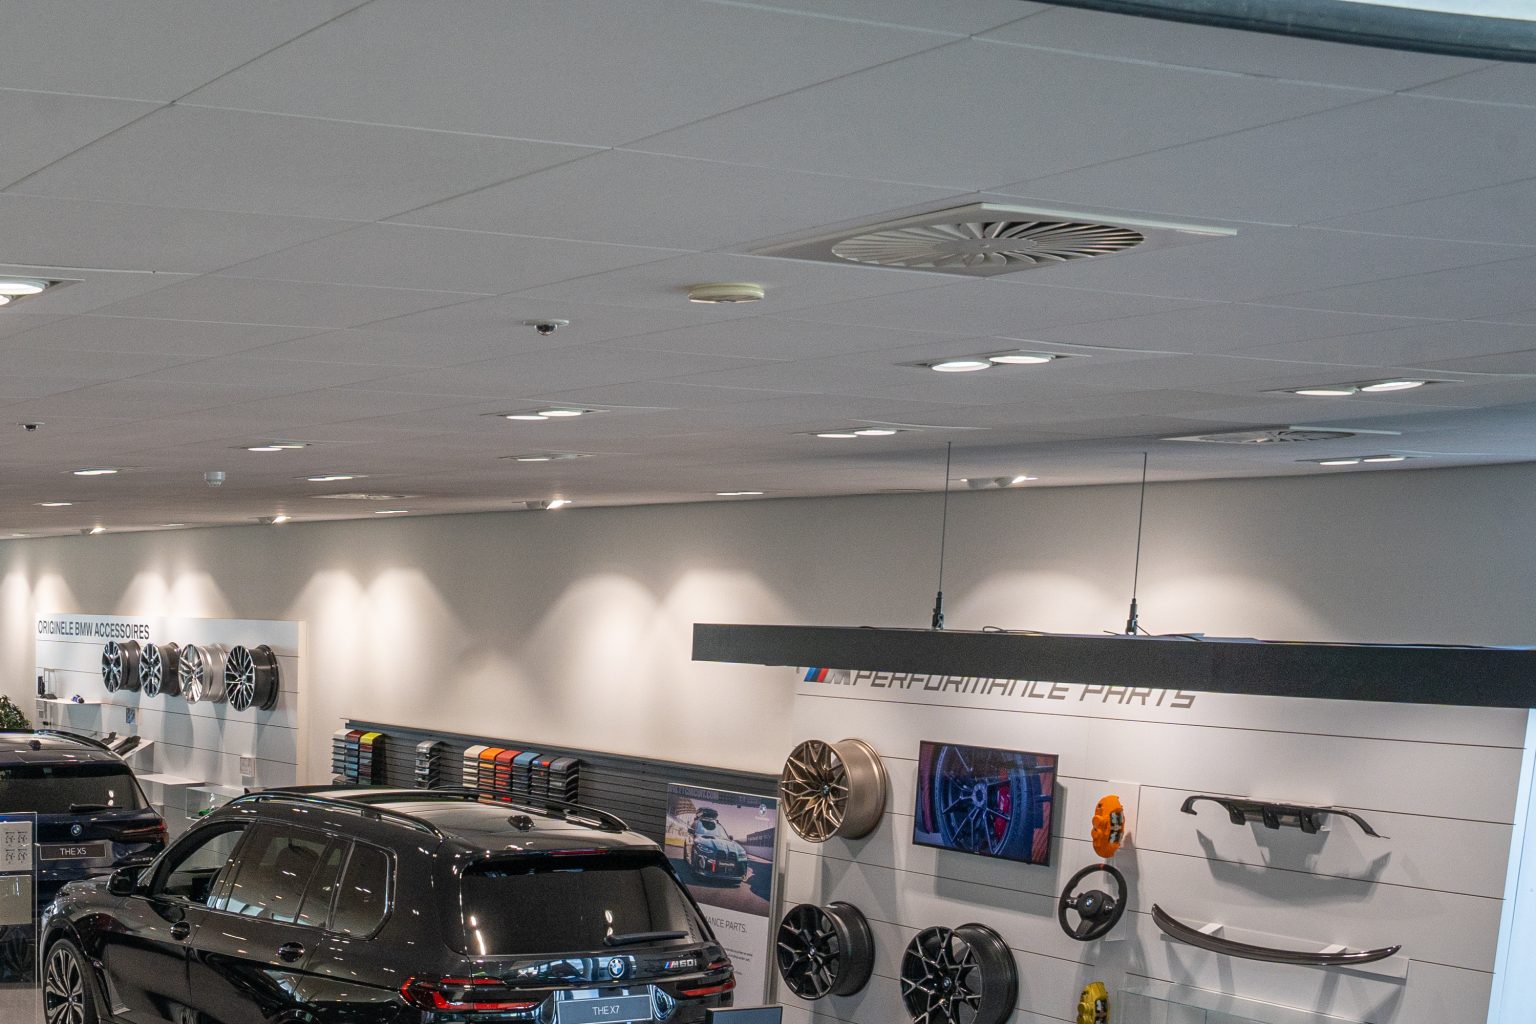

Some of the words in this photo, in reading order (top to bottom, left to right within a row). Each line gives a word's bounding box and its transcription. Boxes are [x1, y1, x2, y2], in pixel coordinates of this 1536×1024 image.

[38, 620, 73, 635] ORIGINELE
[75, 621, 93, 637] BMW
[94, 622, 150, 640] ACCESSOIRES
[60, 847, 76, 856] THE
[706, 915, 724, 928] ANCE
[592, 1006, 609, 1016] THE
[610, 1005, 620, 1014] X7
